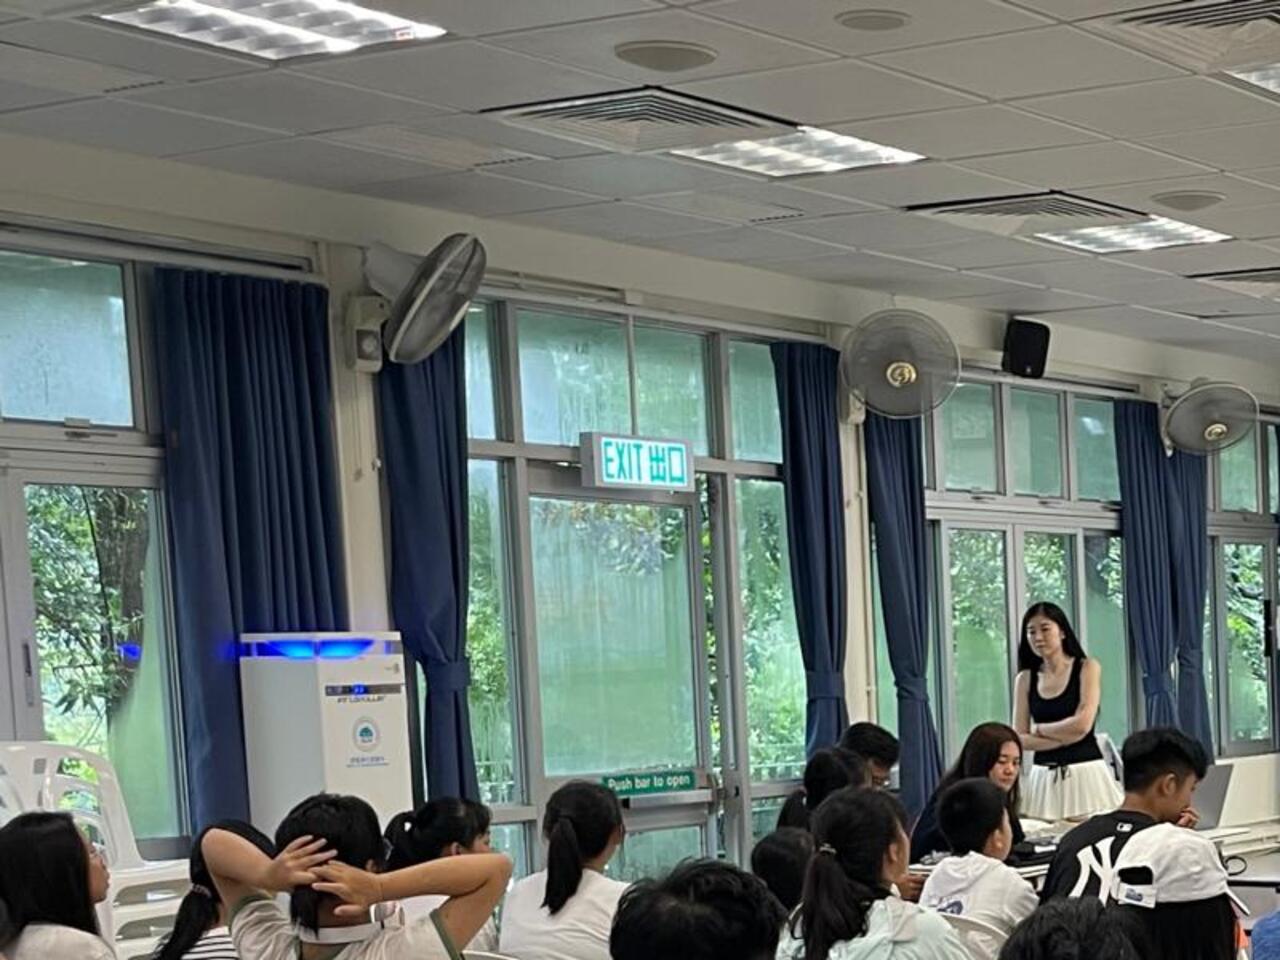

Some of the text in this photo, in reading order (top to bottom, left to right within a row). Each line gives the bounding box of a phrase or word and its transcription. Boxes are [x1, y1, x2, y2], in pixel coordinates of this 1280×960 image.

[603, 441, 686, 484] EXIT 出口
[608, 774, 690, 791] Push bar to open
